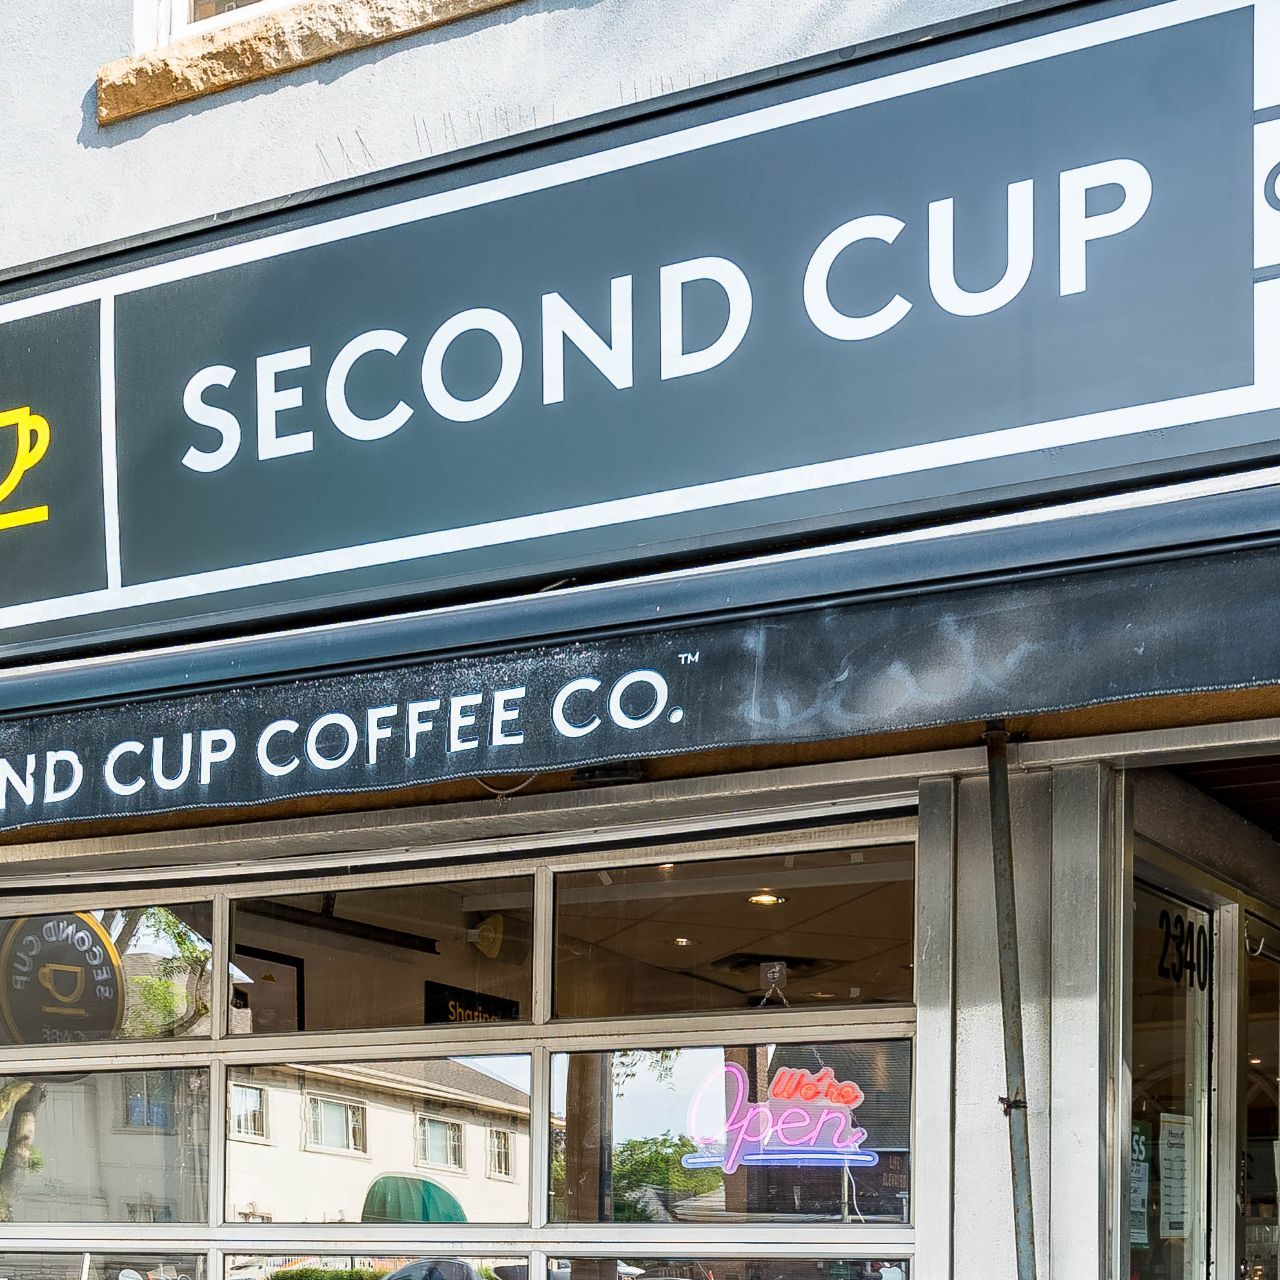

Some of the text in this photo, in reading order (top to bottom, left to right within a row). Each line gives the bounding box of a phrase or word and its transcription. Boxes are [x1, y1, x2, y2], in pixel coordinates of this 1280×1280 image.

[181, 157, 1154, 474] SECOND CUP
[103, 726, 237, 797] CUP
[255, 686, 526, 772] COFFEE
[550, 668, 685, 738] CO.
[1159, 909, 1208, 992] 2340
[689, 1065, 865, 1171] Open
